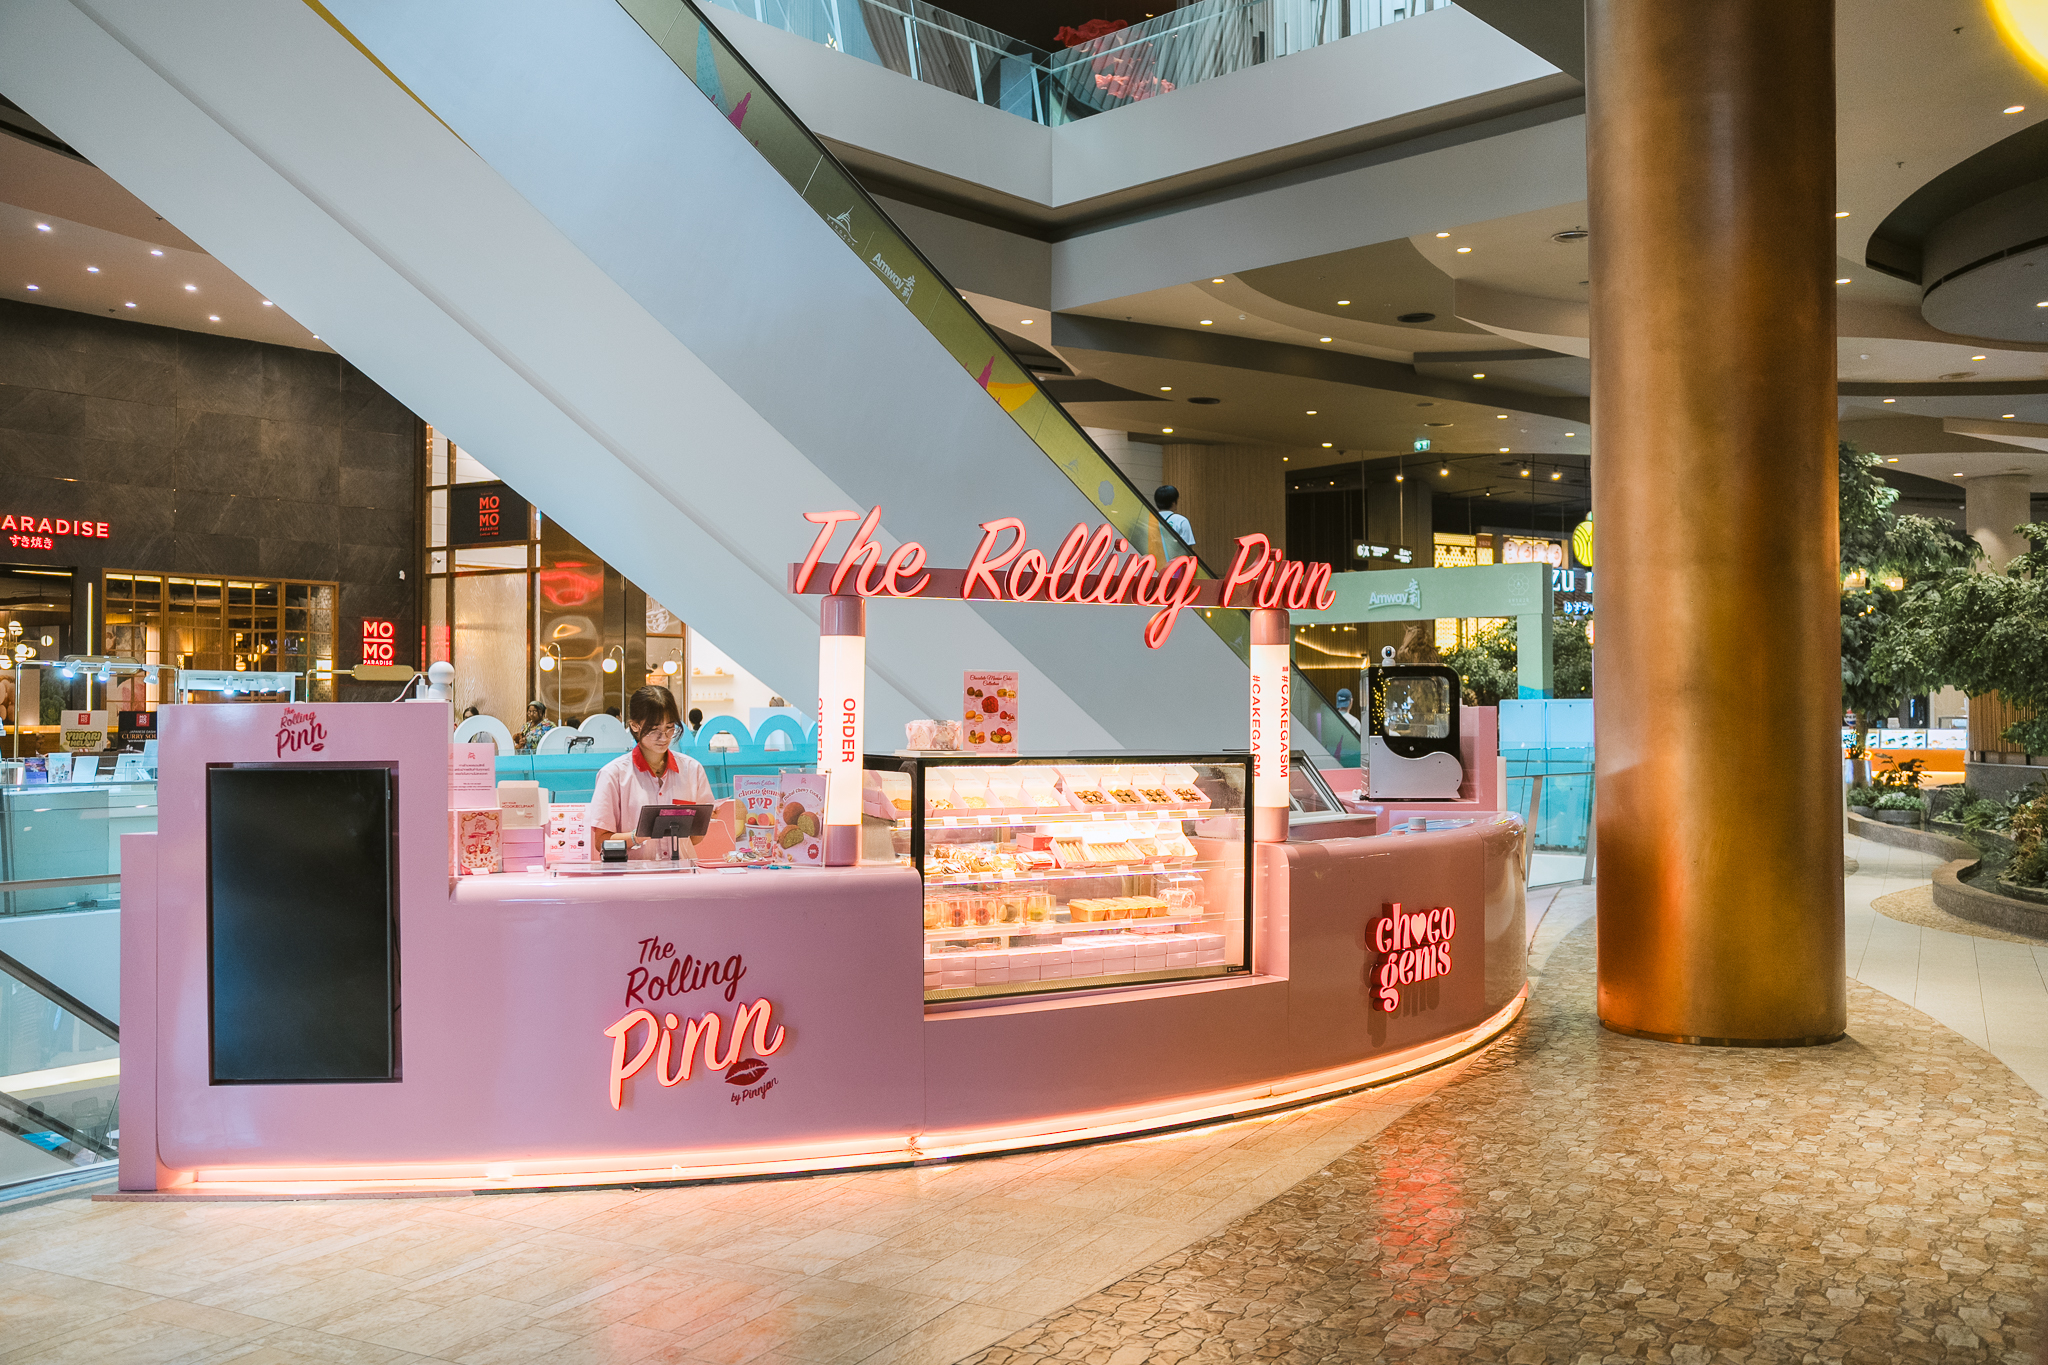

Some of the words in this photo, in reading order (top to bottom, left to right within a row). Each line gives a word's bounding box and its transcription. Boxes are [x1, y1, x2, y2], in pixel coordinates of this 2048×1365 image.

[872, 252, 904, 290] Amway
[480, 496, 499, 509] MO
[0, 514, 109, 538] ARADISE
[480, 513, 499, 527] MO
[9, 535, 53, 550] すき焼き
[794, 505, 931, 597] The
[963, 517, 1201, 650] Rolling
[1221, 533, 1336, 611] Pinn
[1369, 592, 1408, 605] Amway
[363, 621, 394, 638] MO
[363, 643, 394, 660] MO
[281, 711, 317, 728] Rolling
[284, 707, 295, 715] The
[66, 731, 102, 741] YUBARI
[275, 722, 328, 759] Pinn
[842, 698, 856, 763] ORDER
[1252, 675, 1260, 777] #CAKEGASM
[1280, 675, 1288, 777] #CAKEGASM
[638, 935, 676, 965] The
[625, 954, 747, 1007] Rolling
[1379, 941, 1452, 1013] gems
[603, 996, 786, 1111] Pinn
[731, 1092, 741, 1106] by
[742, 1077, 778, 1102] Pinnjan
